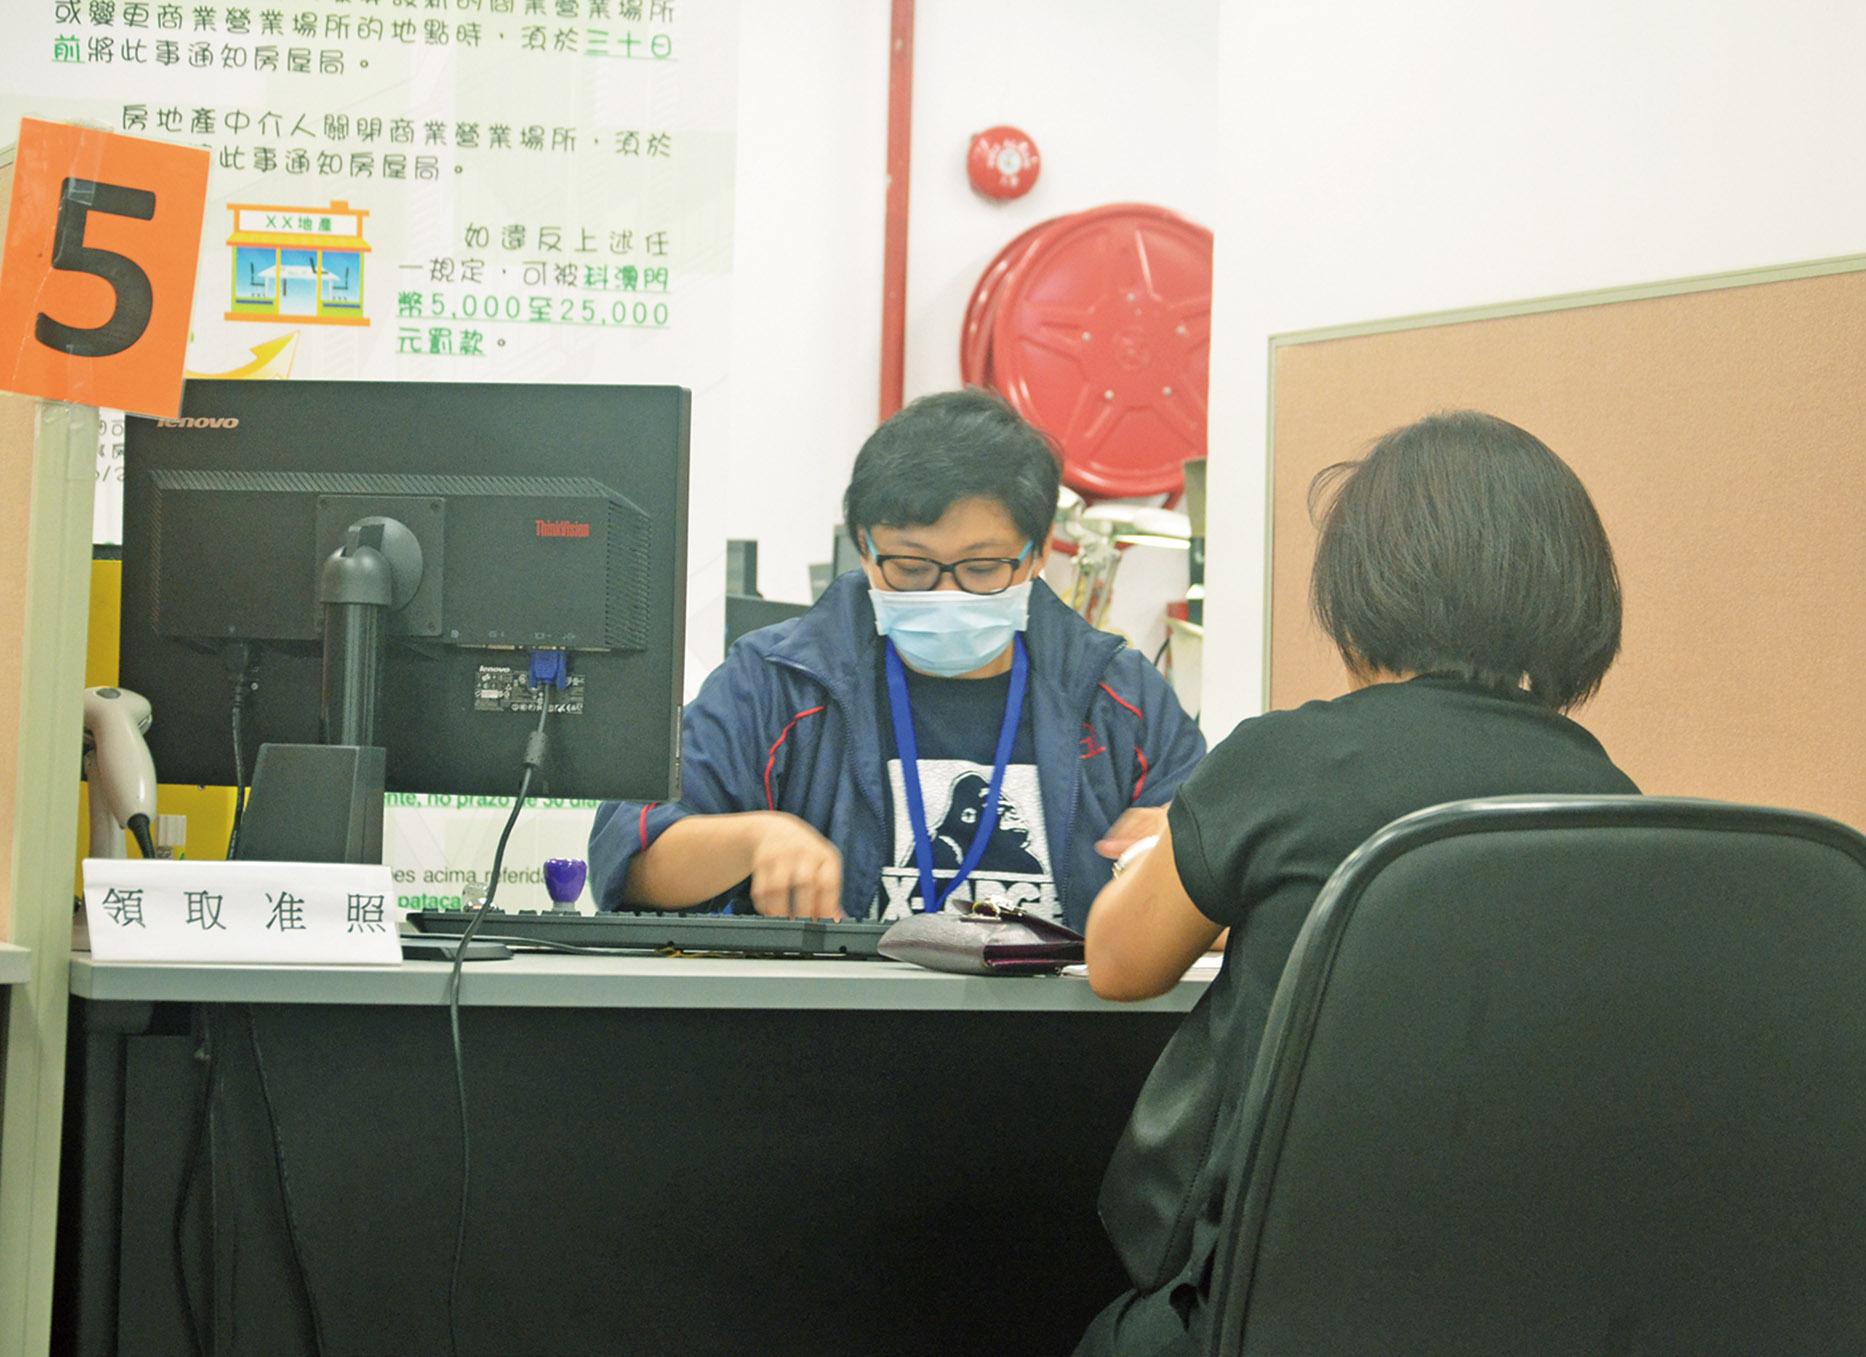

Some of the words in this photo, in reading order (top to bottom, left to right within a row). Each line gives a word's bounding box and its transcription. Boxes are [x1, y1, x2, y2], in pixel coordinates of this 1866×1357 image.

[53, 34, 369, 74] 前將此事通知房屋局。
[189, 143, 463, 180] 此事通知房屋局。
[464, 222, 670, 256] 如違反上述任
[35, 177, 156, 357] 5
[397, 291, 669, 326] 幣5,000至25,000
[397, 327, 506, 355] 元罰款。
[392, 870, 416, 883] es
[423, 866, 477, 884] acima
[101, 887, 387, 934] 領取准照
